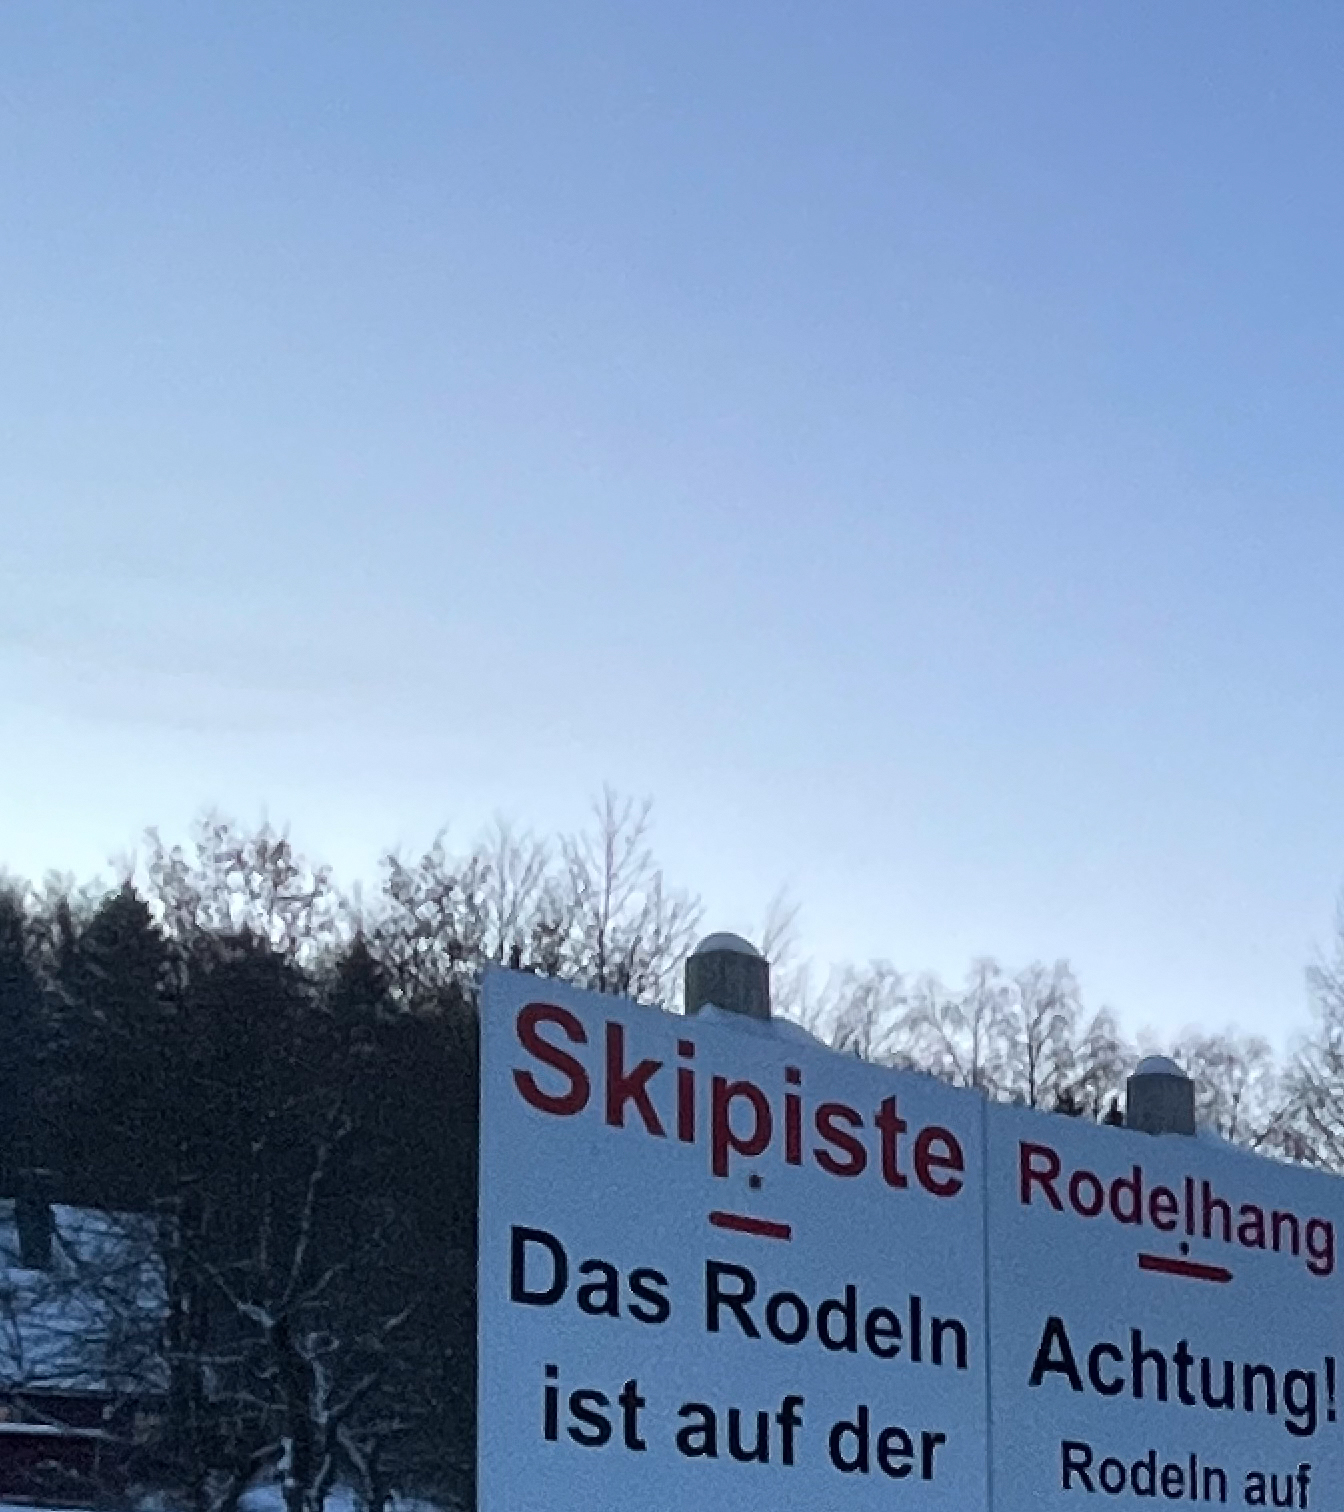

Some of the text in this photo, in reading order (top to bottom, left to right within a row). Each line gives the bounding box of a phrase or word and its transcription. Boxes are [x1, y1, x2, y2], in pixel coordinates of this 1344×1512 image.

[512, 1002, 965, 1197] Skipiste
[1018, 1139, 1335, 1276] Rodelhang
[510, 1224, 968, 1369] Das Rodeln
[543, 1364, 946, 1480] ist auf der
[1028, 1315, 1337, 1437] Achtung!
[1060, 1439, 1312, 1510] Rodeln auf
